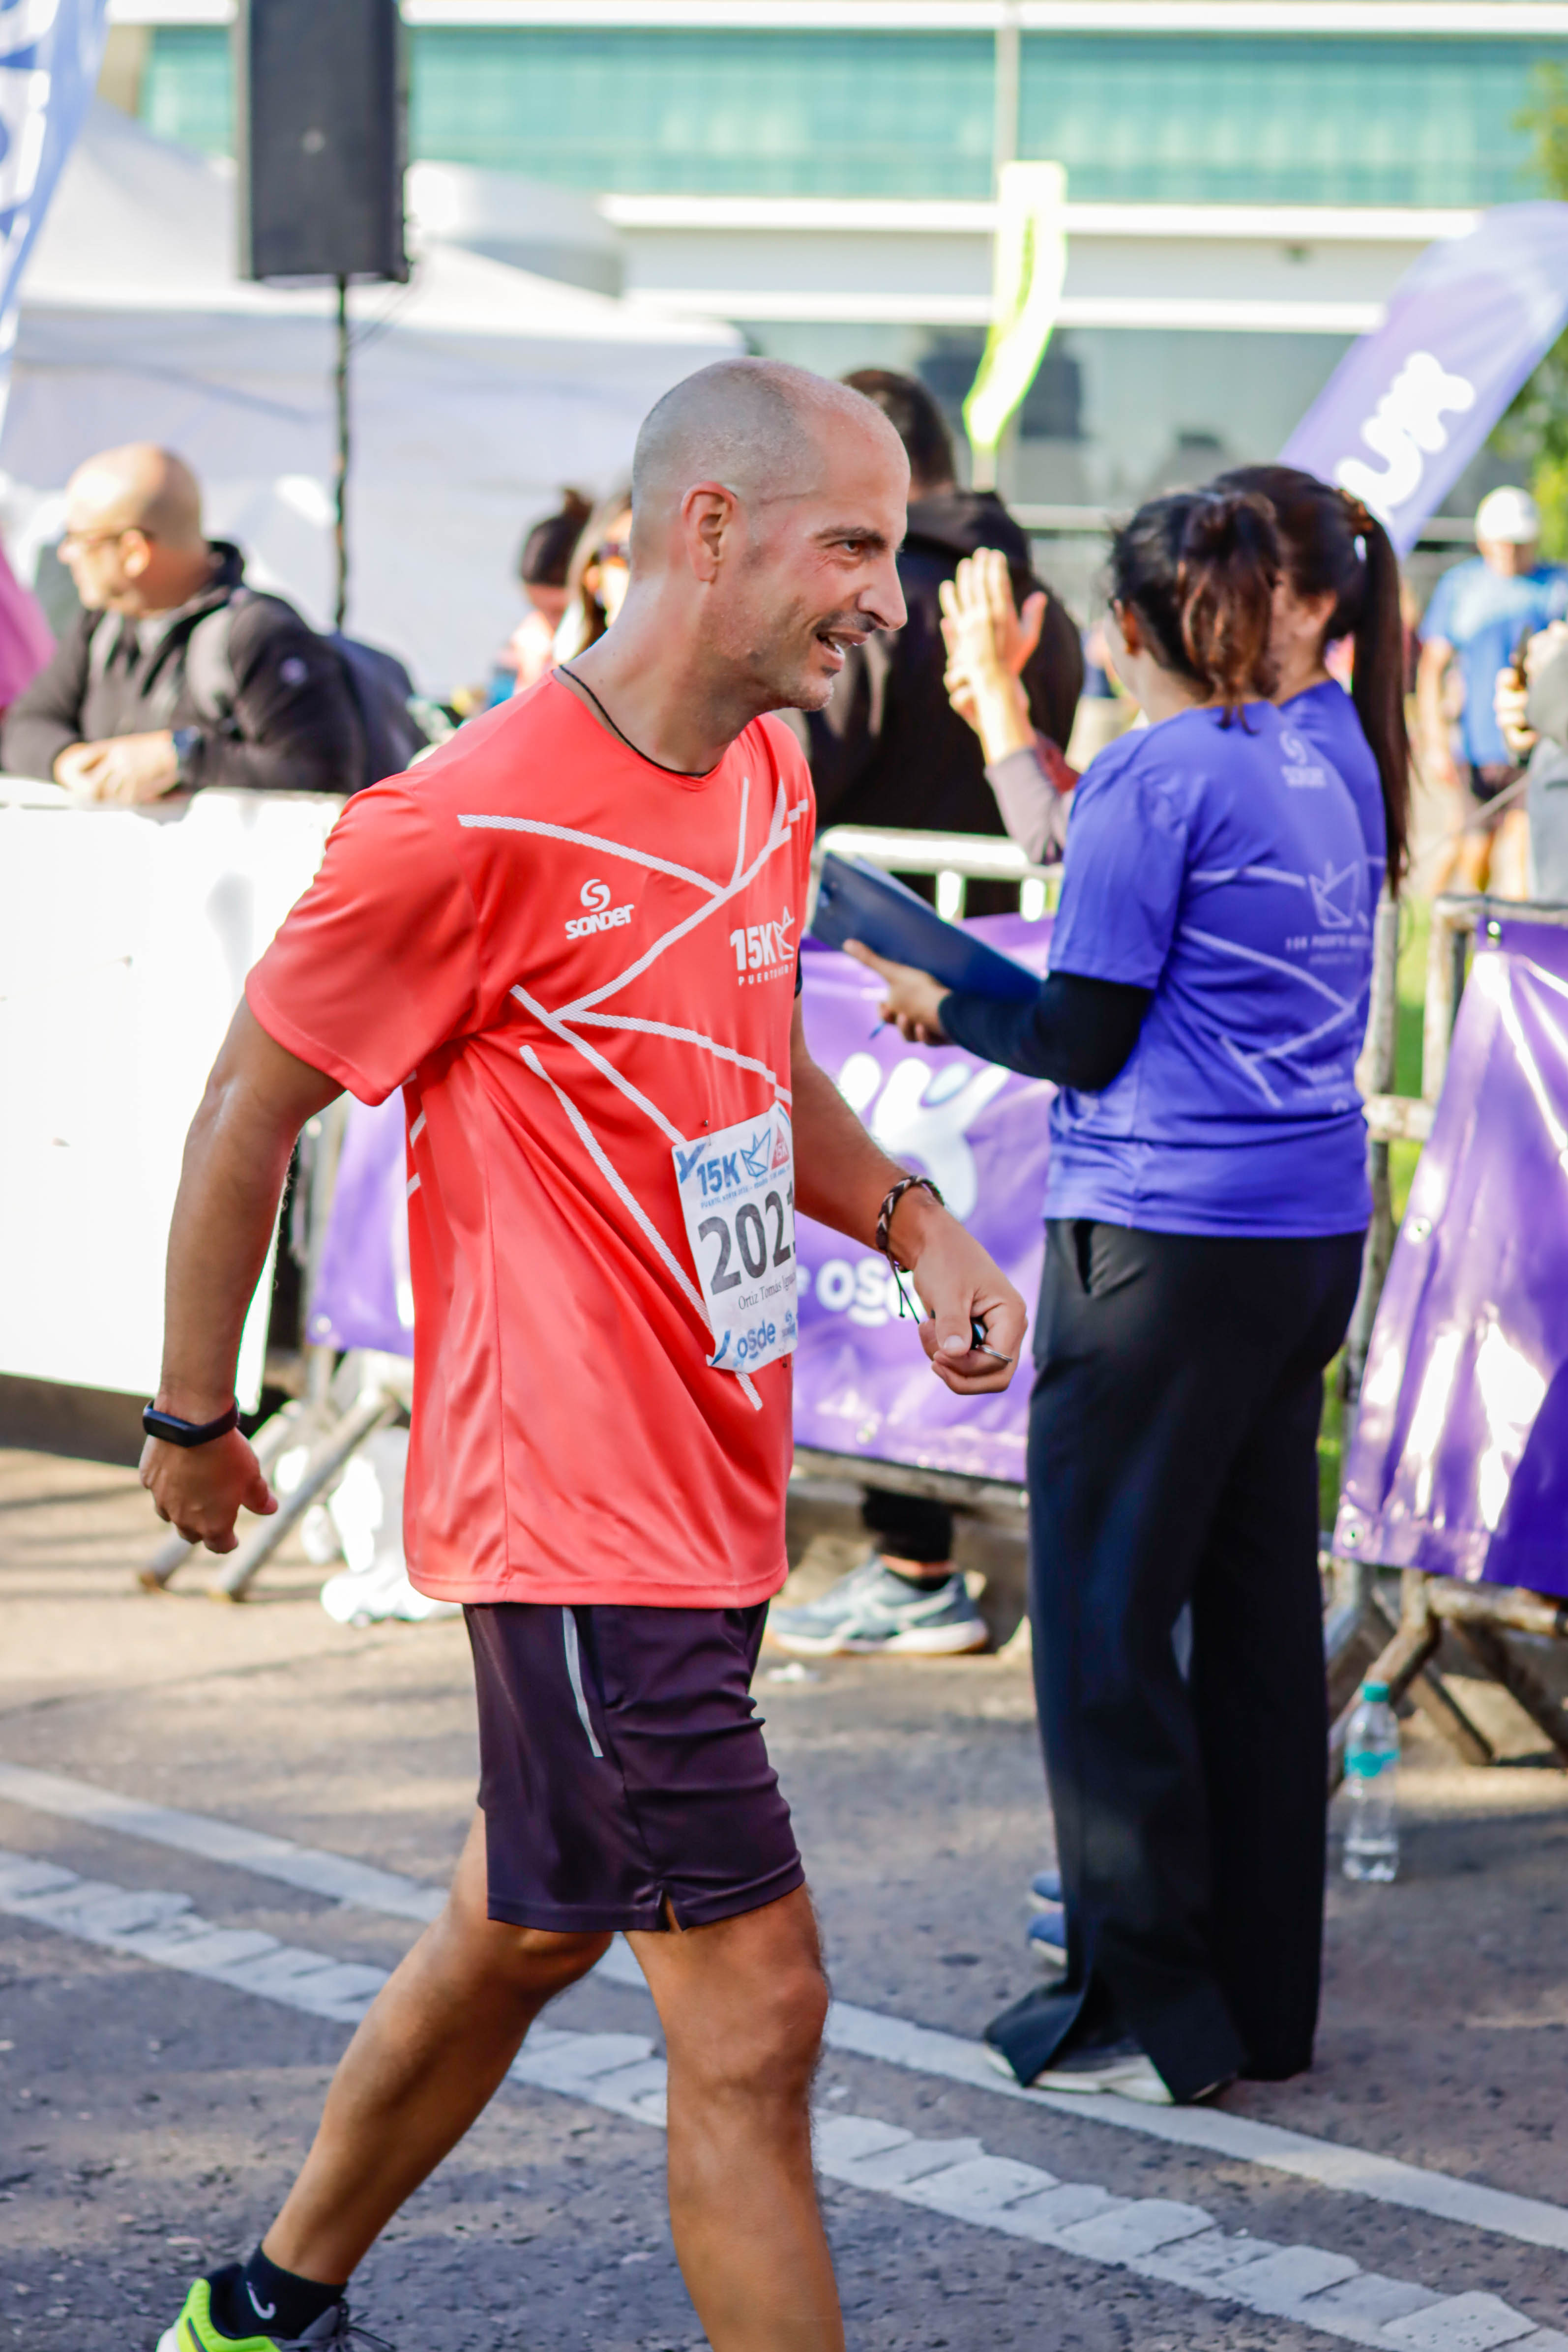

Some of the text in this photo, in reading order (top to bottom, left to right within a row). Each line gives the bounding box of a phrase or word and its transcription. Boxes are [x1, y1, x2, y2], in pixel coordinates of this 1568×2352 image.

[730, 921, 777, 971] 15K
[697, 1150, 741, 1196] 15K
[739, 1291, 759, 1310] Ortiz
[759, 1279, 782, 1300] Tomás
[737, 1319, 776, 1358] osde
